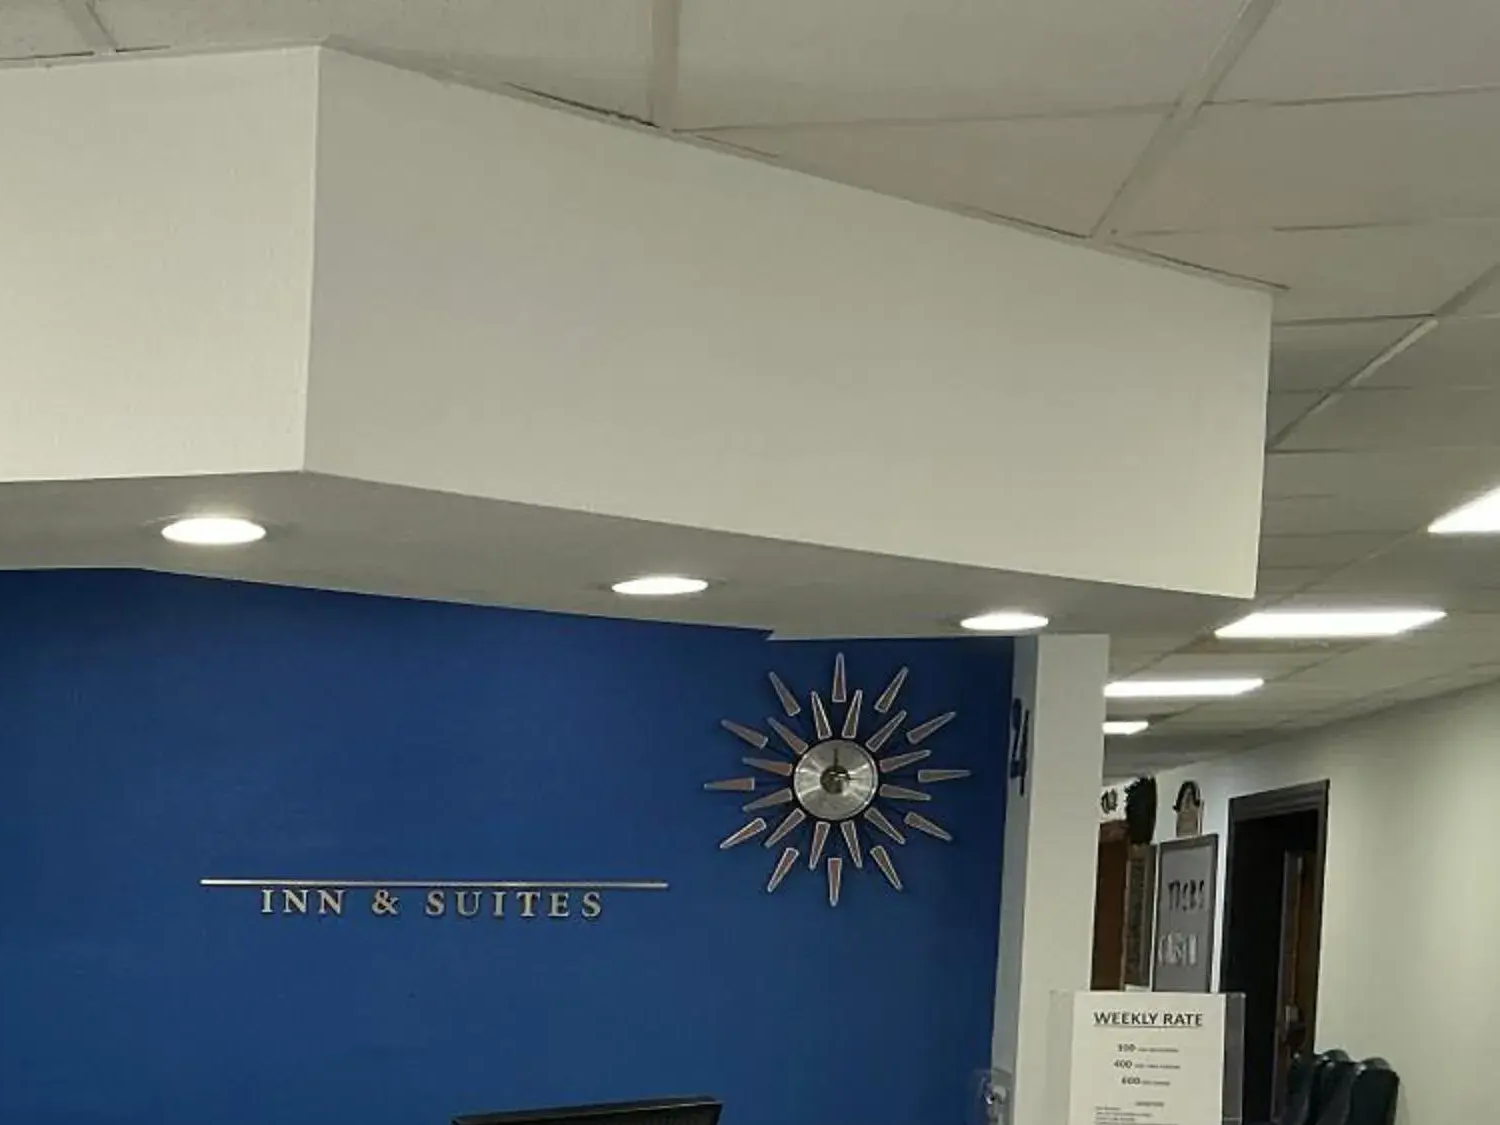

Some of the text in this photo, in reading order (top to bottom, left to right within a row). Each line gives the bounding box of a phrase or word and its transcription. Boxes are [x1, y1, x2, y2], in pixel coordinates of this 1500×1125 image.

[261, 889, 602, 918] INN & SUITES
[1093, 1011, 1204, 1027] WEEKLY RATE
